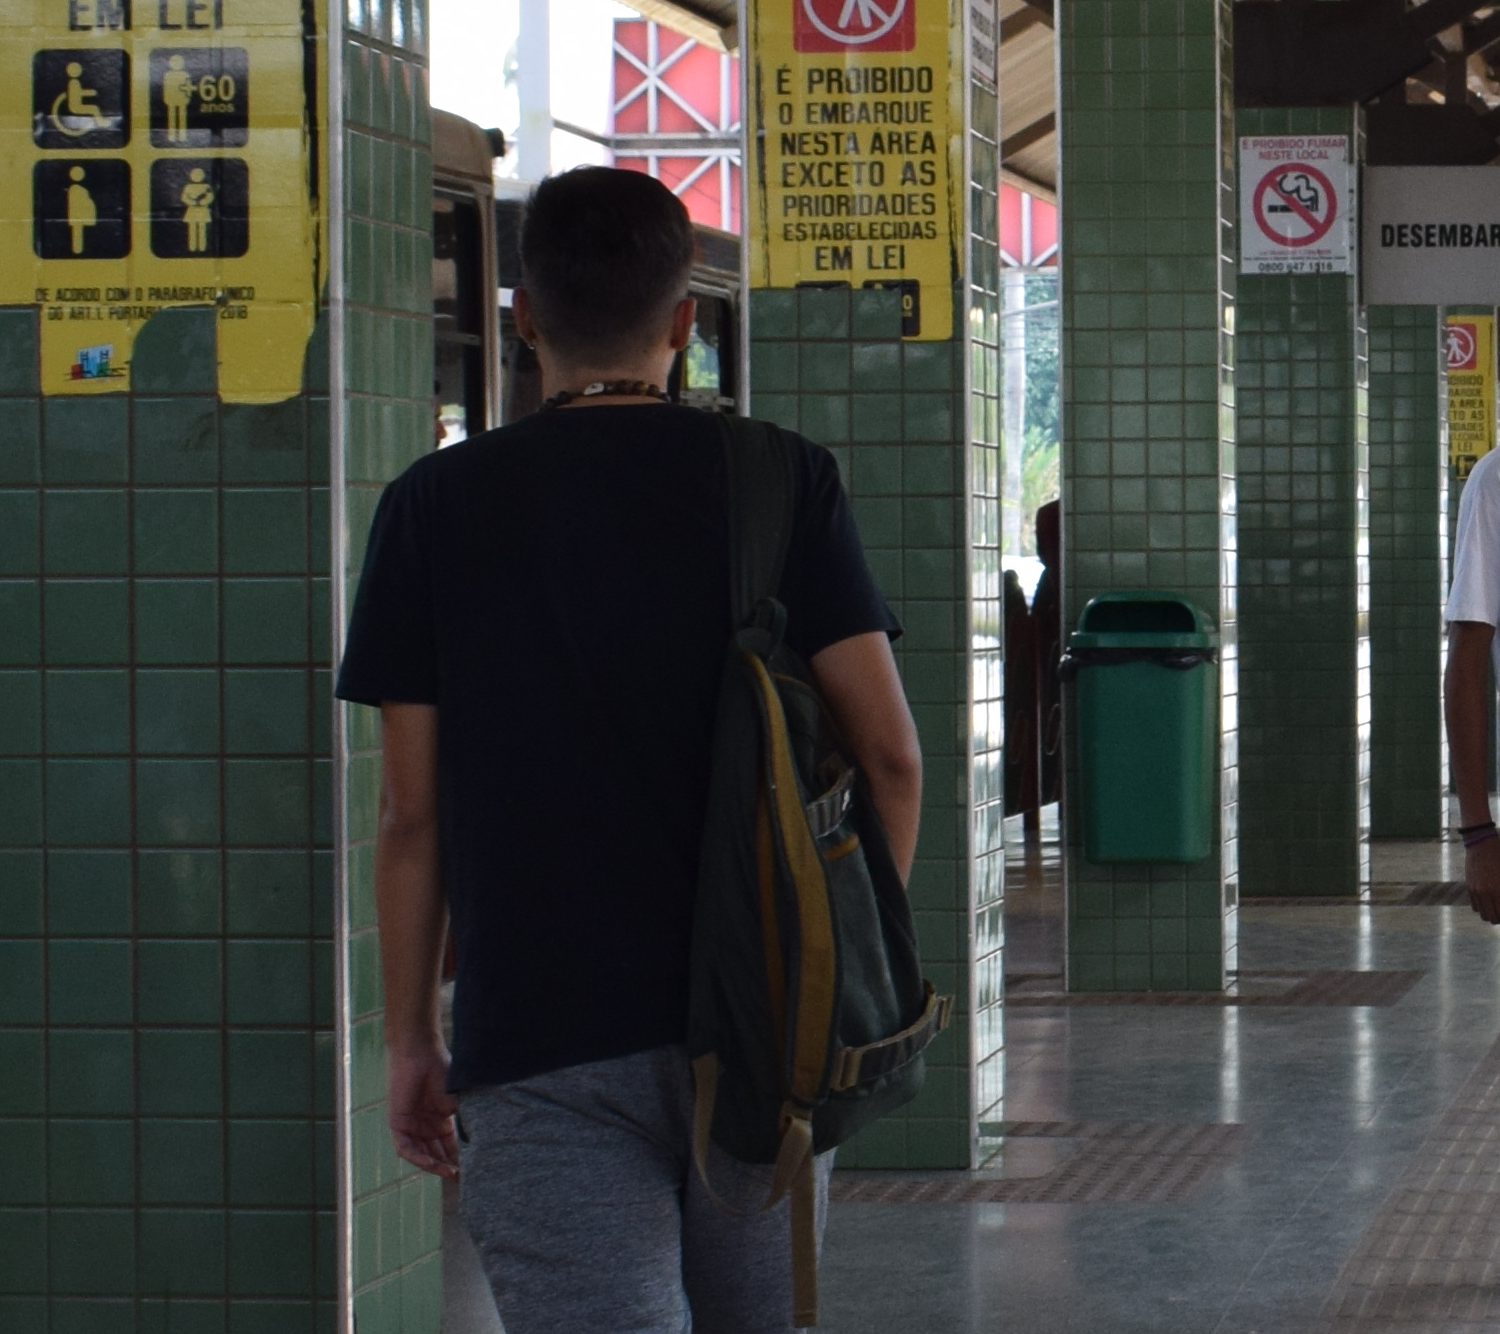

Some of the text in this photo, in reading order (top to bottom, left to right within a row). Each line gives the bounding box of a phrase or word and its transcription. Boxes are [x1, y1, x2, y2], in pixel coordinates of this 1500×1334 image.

[179, 74, 235, 102] +60
[777, 64, 933, 95] É PROIBIDO
[200, 103, 235, 113] anos
[779, 101, 933, 125] O EMBARQUE
[781, 126, 936, 156] NESTA ÁREA
[1252, 138, 1304, 149] PROIBIDO
[1308, 137, 1346, 148] FUMAR
[1260, 149, 1329, 160] NESTE LOCAL
[782, 160, 936, 188] EXCETO AS
[783, 193, 936, 217] PRIORIDADES
[783, 220, 937, 241] ESTABELECIDAS
[816, 244, 905, 271] EM LEI
[35, 288, 49, 302] DE
[56, 288, 100, 302] ACORDO
[106, 287, 130, 302] COM
